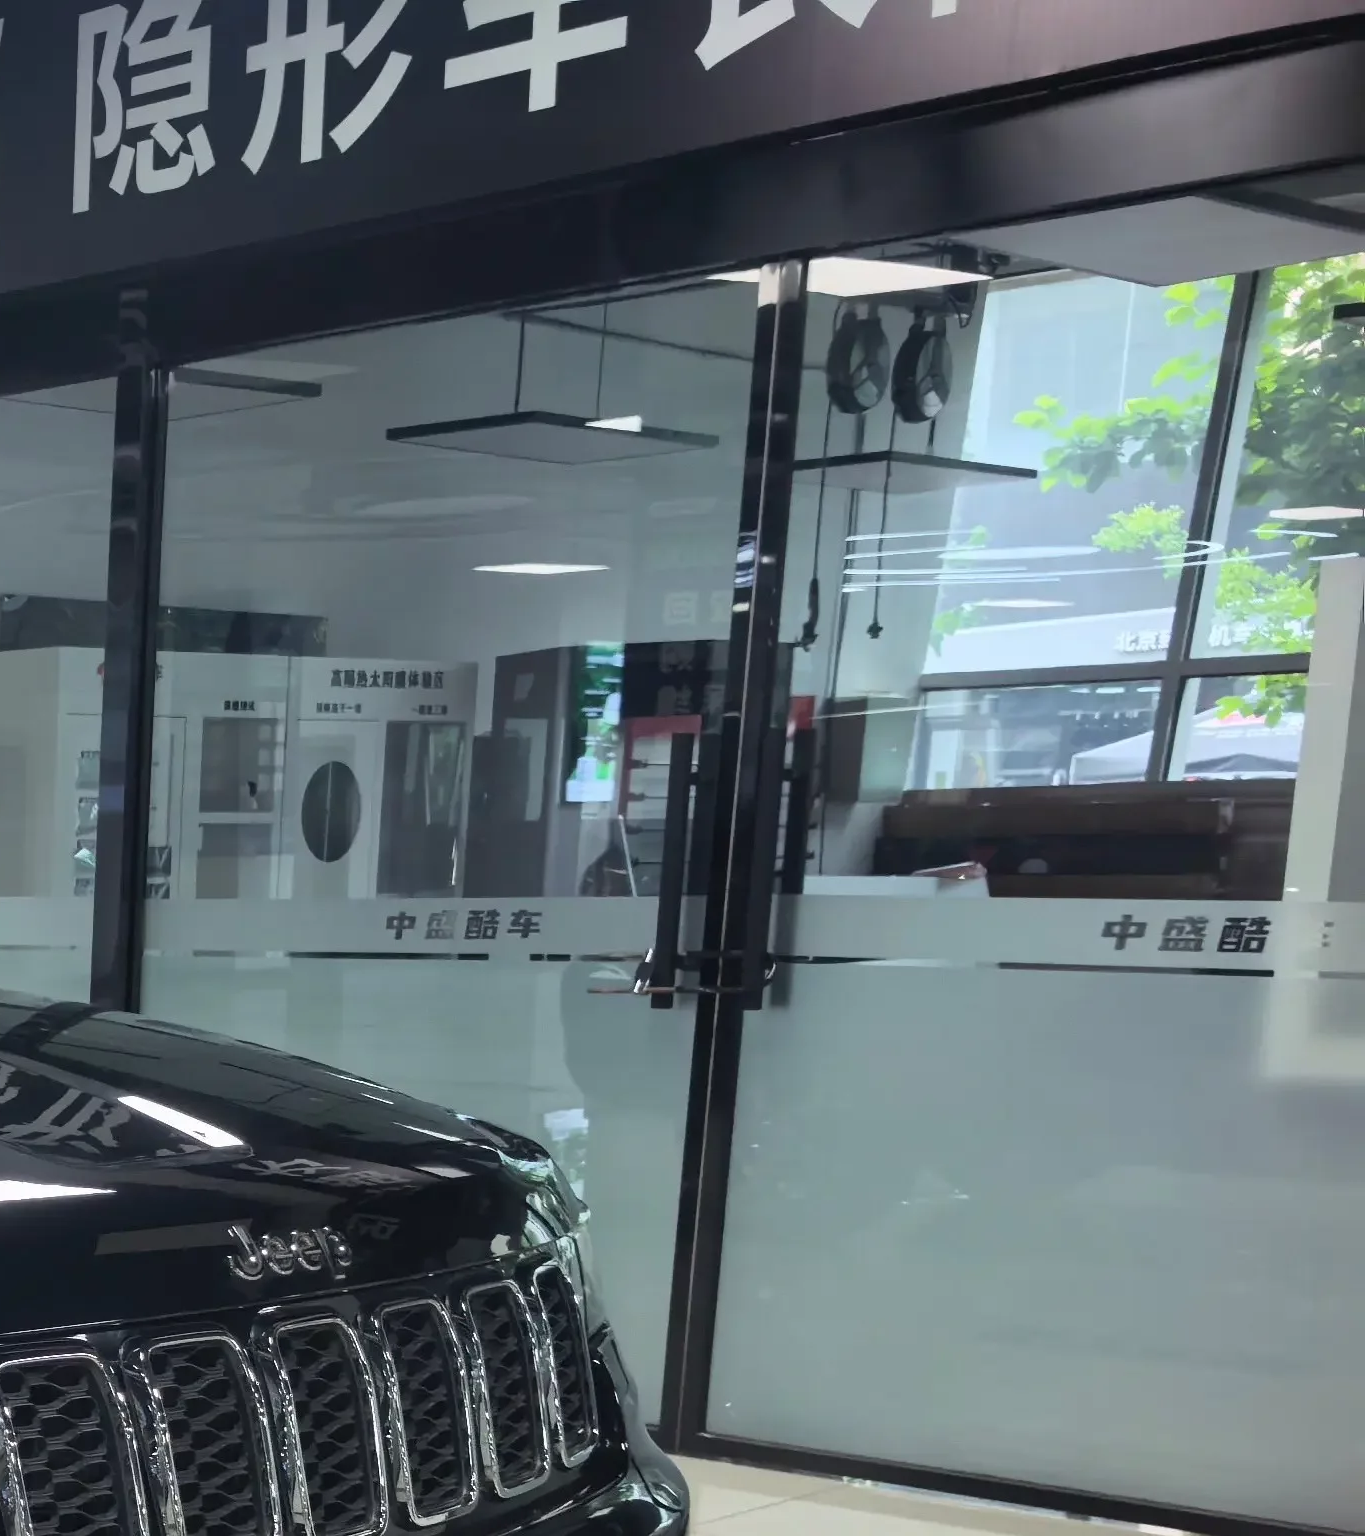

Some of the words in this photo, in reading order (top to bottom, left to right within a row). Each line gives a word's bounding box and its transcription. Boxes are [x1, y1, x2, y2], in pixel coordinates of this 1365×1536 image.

[72, 0, 959, 214] 隐形车
[385, 908, 543, 941] 中盛酷车
[1100, 914, 1335, 955] 中盛酷
[226, 1224, 353, 1281] Jeep
